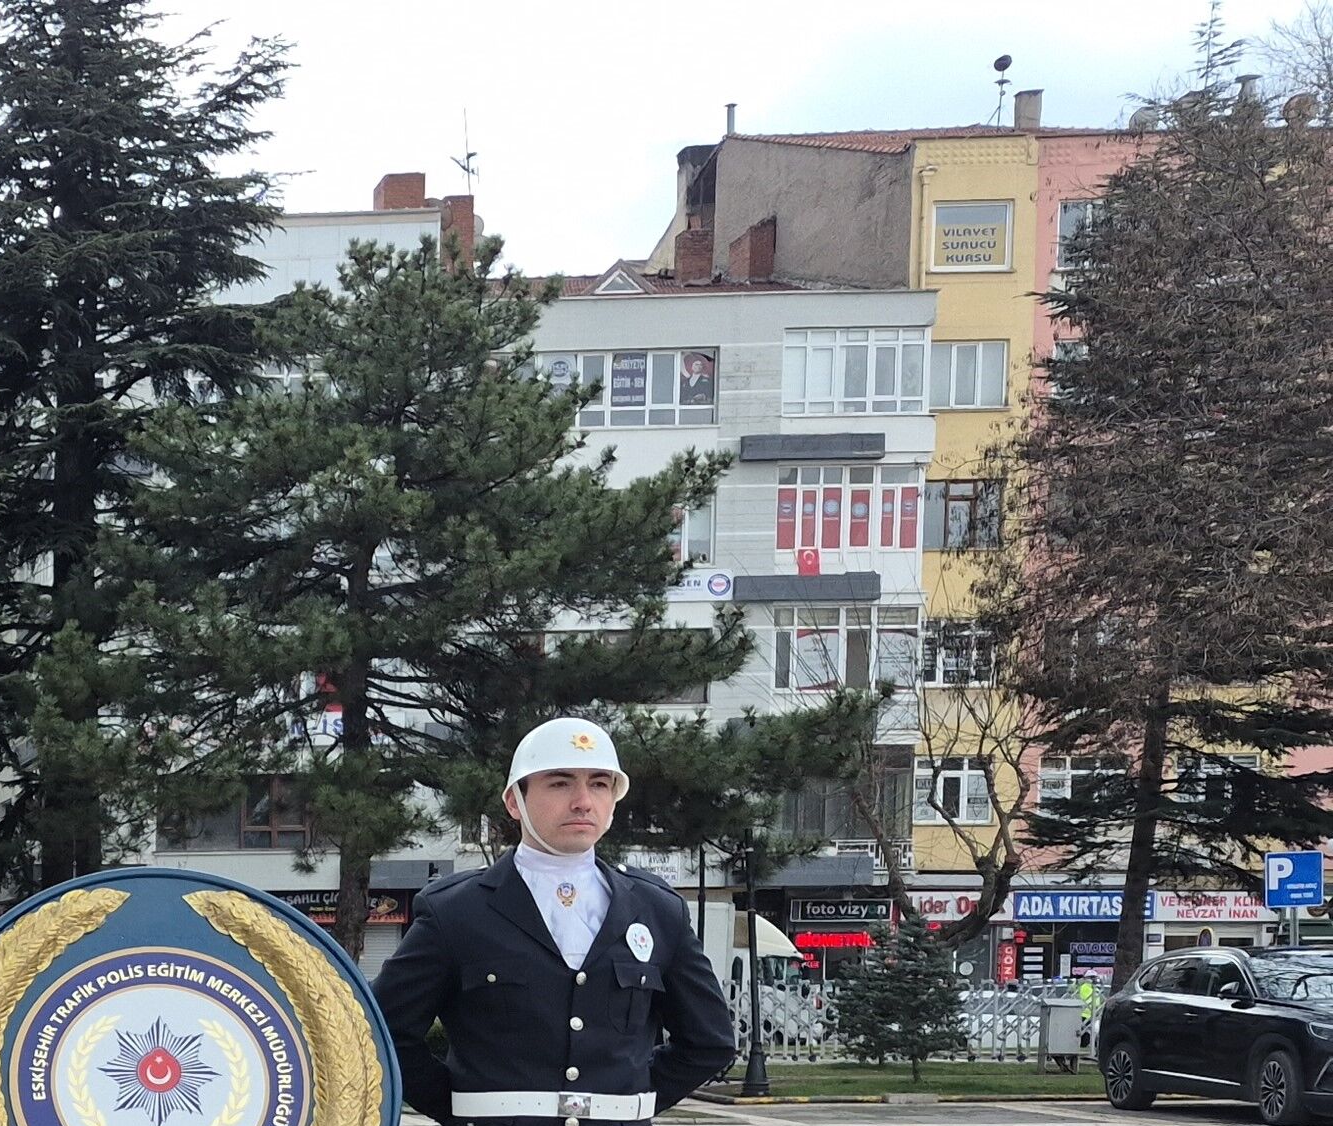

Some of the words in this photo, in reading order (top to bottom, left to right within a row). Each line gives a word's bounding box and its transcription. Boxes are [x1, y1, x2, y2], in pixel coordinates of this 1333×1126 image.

[946, 253, 992, 263] KURSU
[806, 902, 836, 916] foto
[839, 902, 887, 921] vizyon
[909, 896, 950, 915] ider
[1017, 895, 1055, 917] ADA
[1058, 895, 1152, 917] KIRTASE
[1176, 909, 1223, 919] NEVZAT
[1069, 941, 1117, 954] FOTOKO
[29, 1025, 58, 1101] ESKİŞEHİR
[50, 982, 98, 1025] TRAFİK
[96, 963, 144, 990] POLİS
[146, 962, 206, 984] EĞİTİM
[205, 975, 270, 1027] MERKEZİ
